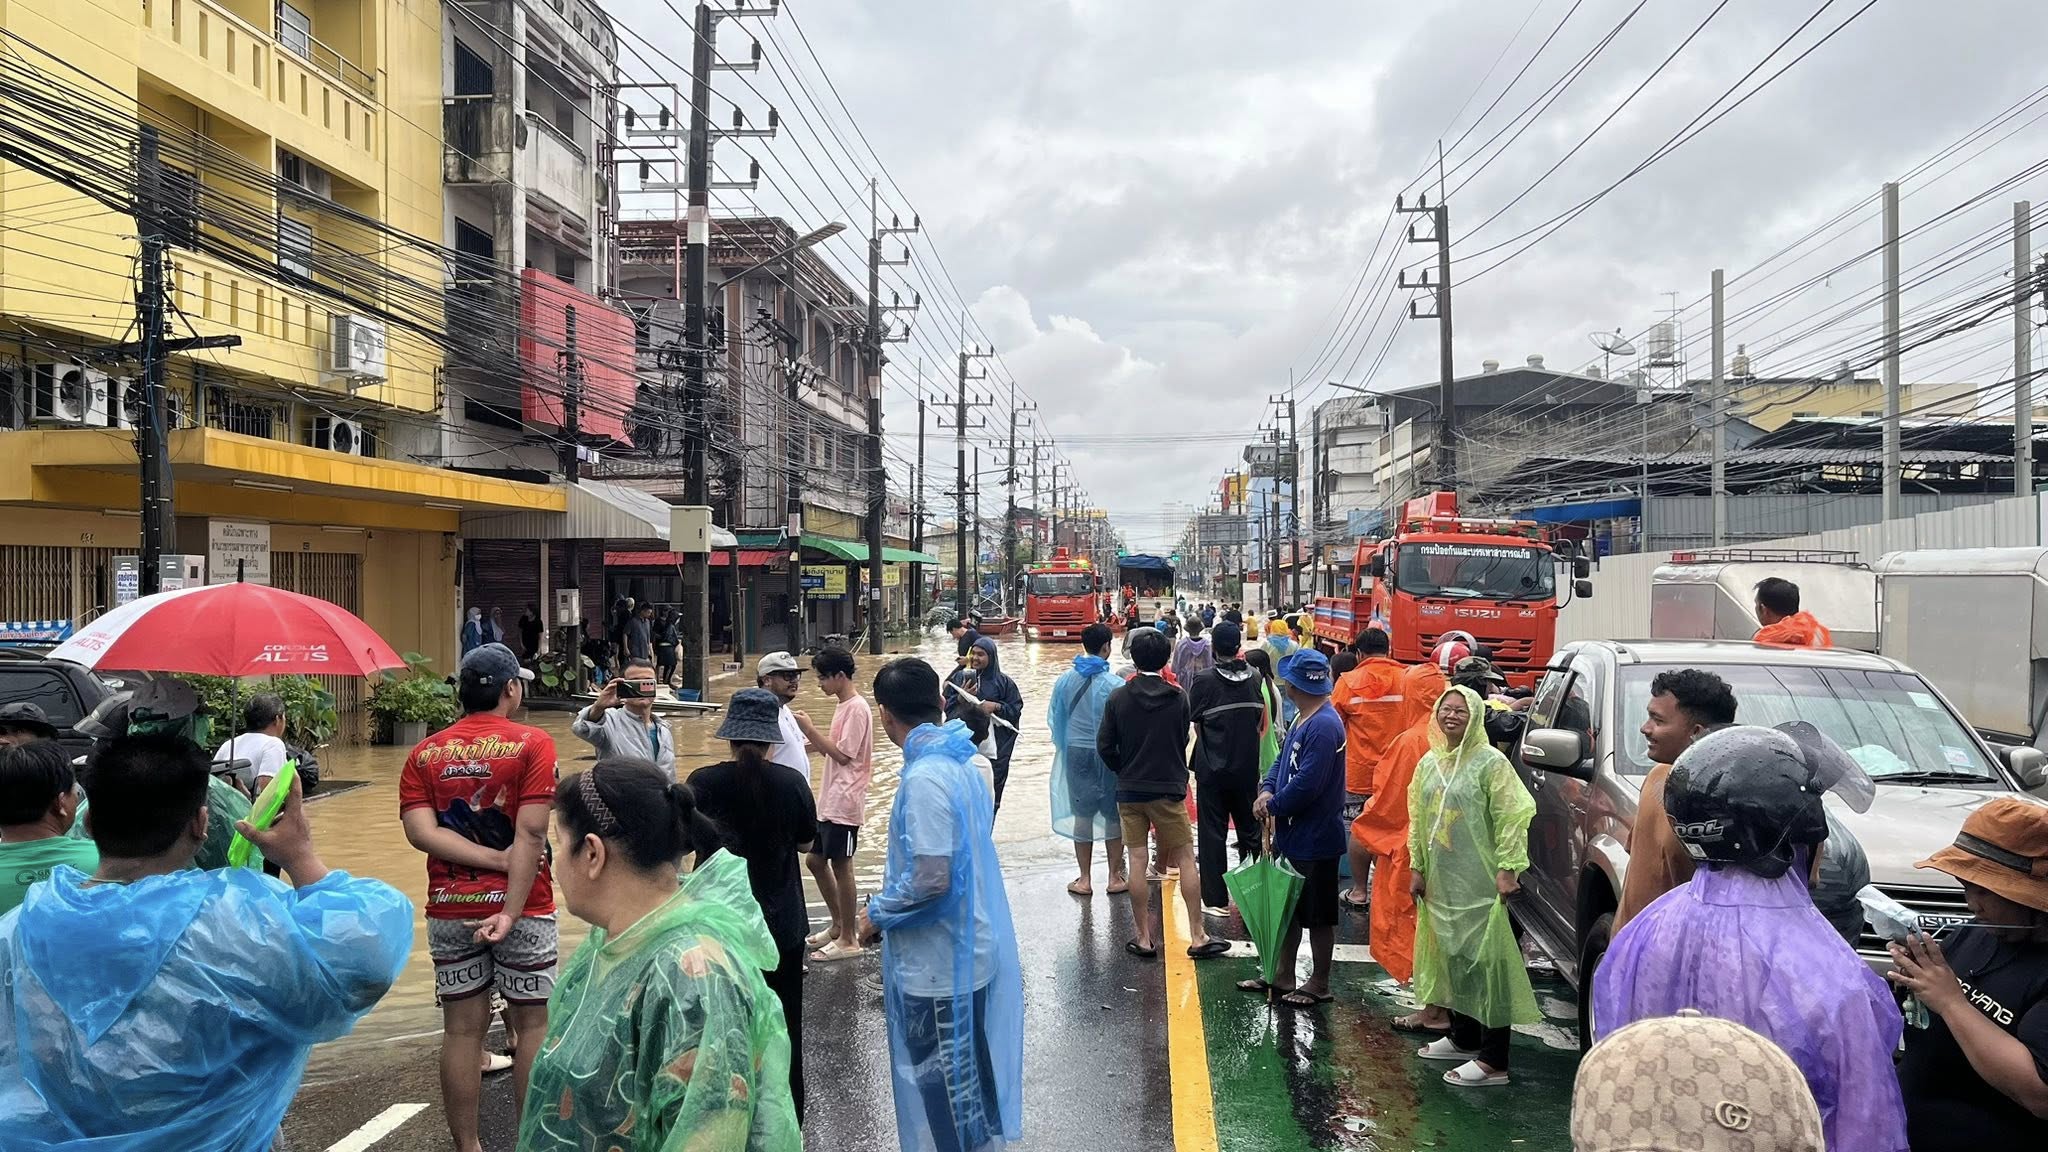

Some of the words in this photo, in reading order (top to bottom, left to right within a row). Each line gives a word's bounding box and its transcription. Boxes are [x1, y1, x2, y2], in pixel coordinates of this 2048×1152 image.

[1454, 608, 1500, 618] ISUZU
[251, 651, 329, 662] ALTIS
[1969, 989, 2015, 1026] YANG
